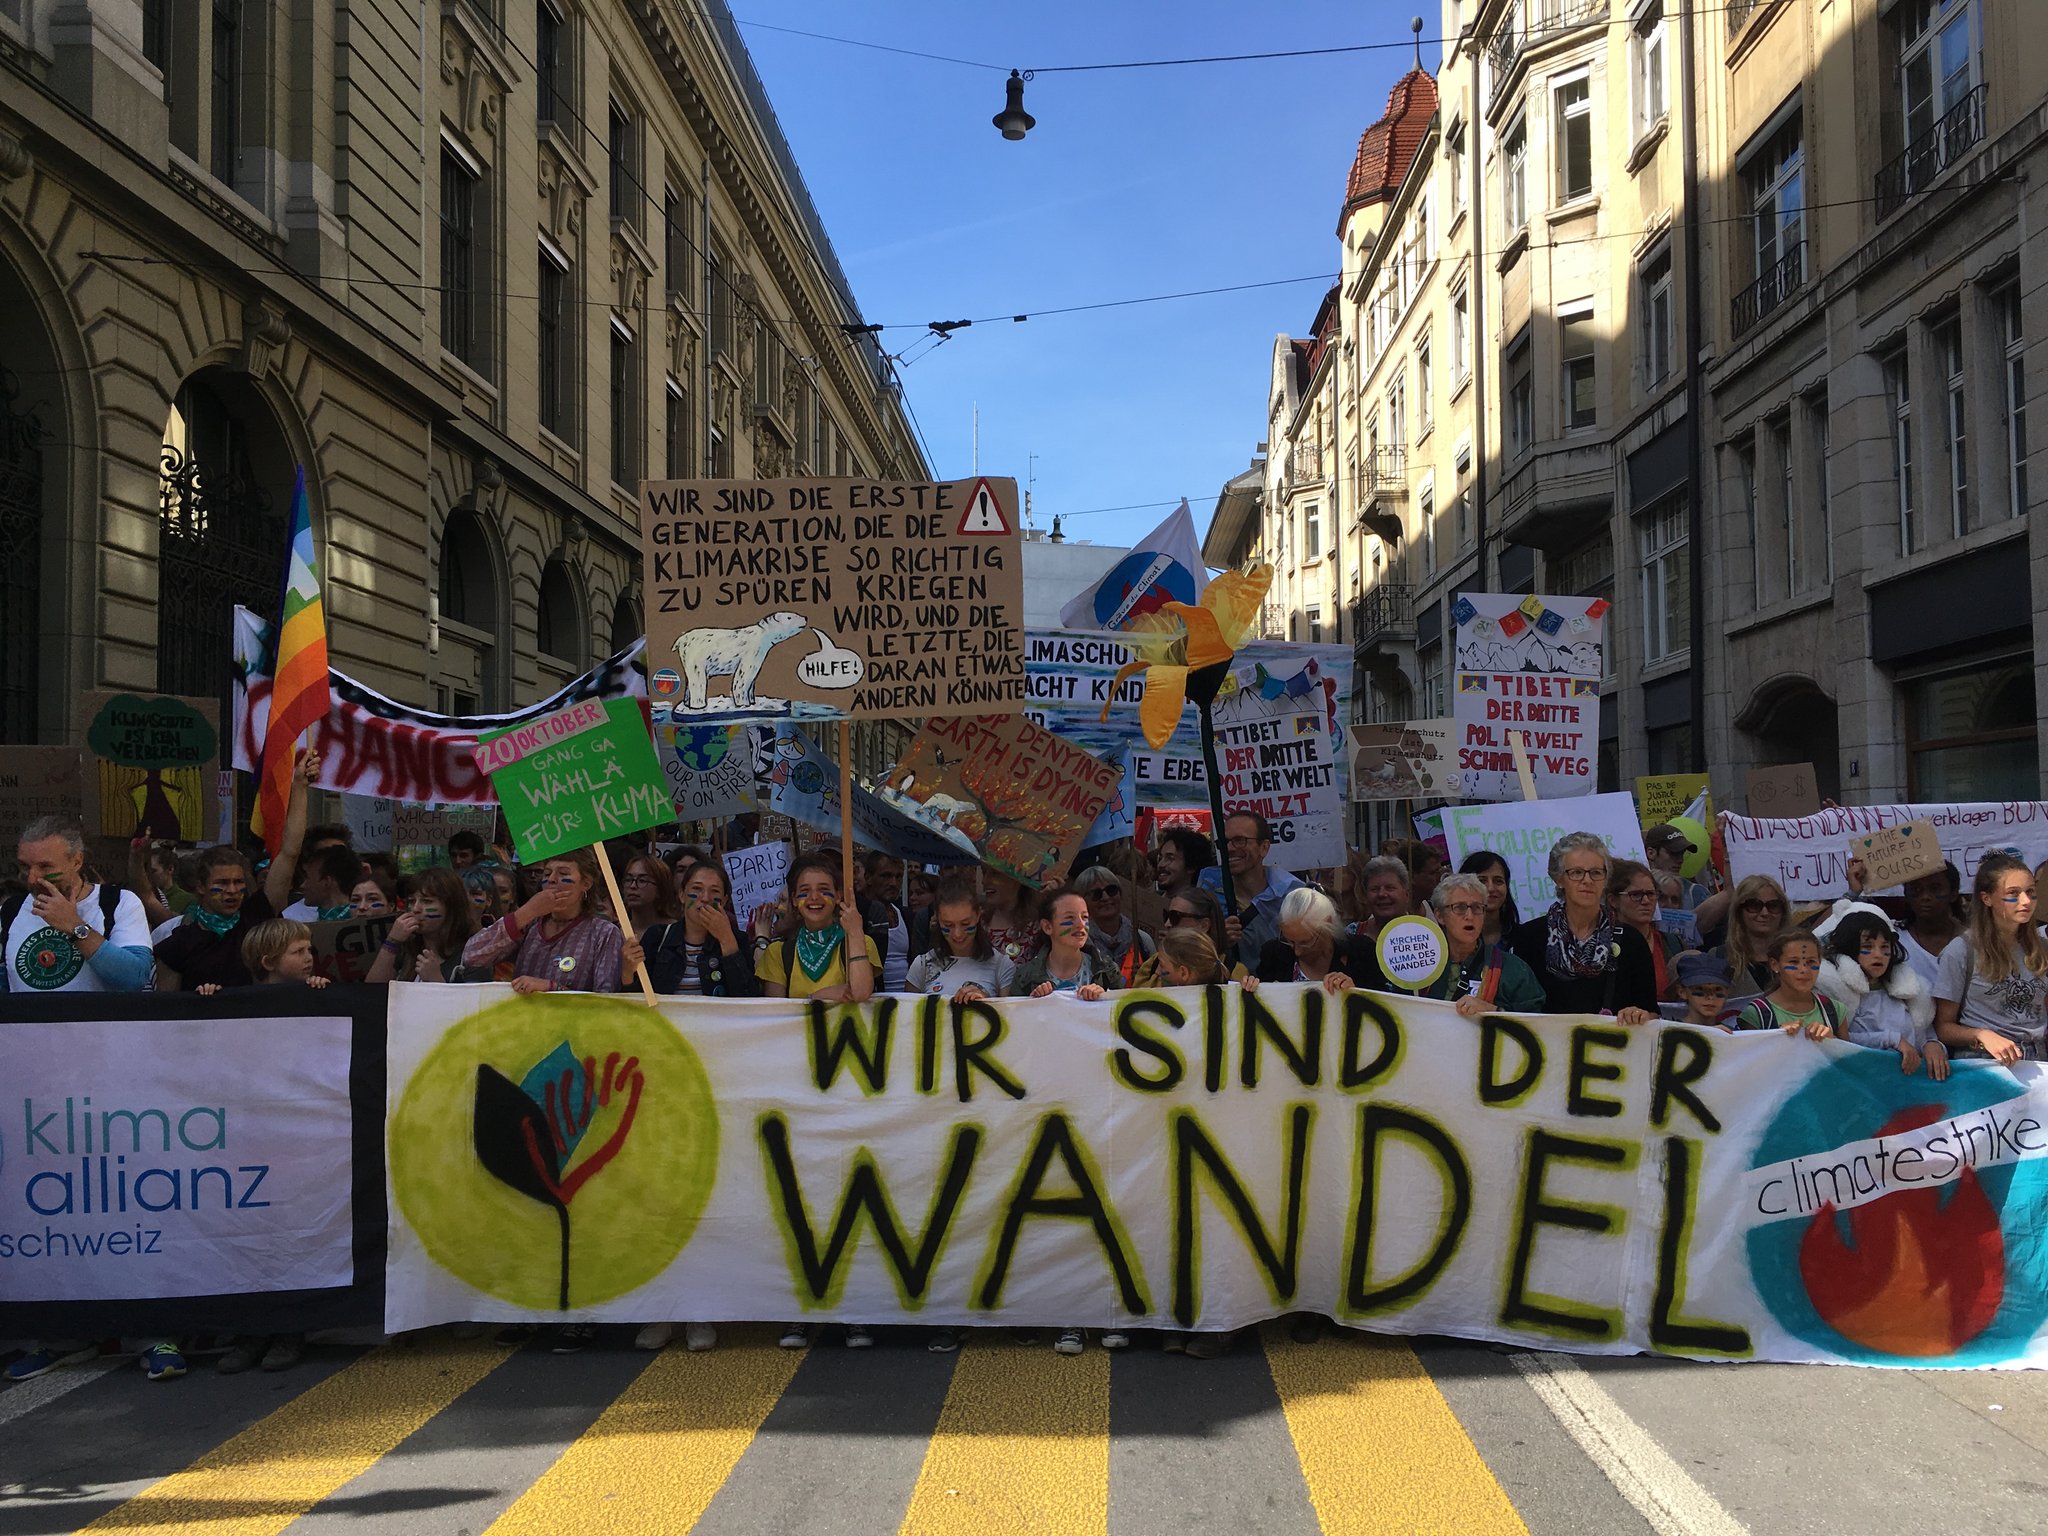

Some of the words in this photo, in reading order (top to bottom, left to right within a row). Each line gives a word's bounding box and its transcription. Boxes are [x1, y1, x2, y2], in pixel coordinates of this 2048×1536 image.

[648, 488, 703, 515] WIR
[713, 488, 774, 513] SIND
[789, 487, 832, 510] DIE
[850, 485, 953, 510] ERSTE
[652, 515, 846, 545] GENERATION,
[854, 514, 894, 540] DIE
[905, 514, 947, 540] DIE
[654, 546, 830, 582] KLIMAKRISE
[846, 545, 880, 572] SO
[892, 545, 1003, 574] RICHTIG
[1137, 565, 1161, 592] Climat
[657, 586, 701, 612] ZU
[715, 575, 831, 605] SPÜREN
[857, 574, 986, 602] KRIEGEN
[833, 604, 909, 633] WIRD,
[916, 604, 959, 627] UND
[969, 605, 1009, 628] DIE
[867, 629, 977, 657] LETZTE,
[984, 629, 1019, 652] DIE
[805, 660, 859, 677] HILFE!
[868, 657, 946, 683] DARAN
[955, 654, 1024, 677] ETWAS
[851, 683, 936, 711] ÄNDERN
[947, 678, 1025, 705] KÖNNTE
[1091, 679, 1147, 702] KIND
[1493, 674, 1571, 698] TIBET
[1487, 698, 1524, 721] DER
[1527, 702, 1580, 723] DRITTE
[125, 728, 145, 744] IST
[476, 737, 515, 774] 20
[517, 703, 601, 750] OKTOBER
[1226, 719, 1281, 745] TIBET
[1382, 725, 1446, 738] Artenschutz
[1466, 723, 1498, 747] POL
[1503, 728, 1532, 748] DR
[1534, 731, 1583, 751] WELT
[109, 741, 200, 760] VERBRECHEN
[532, 745, 584, 771] GANG
[591, 737, 616, 753] GA
[1016, 723, 1115, 790] DENYING
[1225, 747, 1257, 772] DER
[1259, 738, 1318, 768] DRITTE
[1381, 748, 1444, 761] Klimaschutz
[1458, 748, 1539, 774] SCHMILT
[1543, 754, 1589, 776] WEG
[666, 760, 693, 787] OUR
[699, 753, 743, 788] HOUSE
[927, 716, 1009, 766] EARTH
[1009, 752, 1036, 779] IS
[1032, 765, 1104, 821] DYING
[1251, 769, 1282, 794] DER
[1283, 763, 1334, 789] WELT
[671, 786, 688, 803] IS
[693, 791, 714, 807] ON
[717, 771, 751, 800] FIRE
[1648, 790, 1675, 800] JUSTICE
[393, 811, 442, 826] WHICH
[446, 812, 492, 826] GREEN
[592, 783, 673, 832] KLIMA
[763, 815, 786, 827] THE
[1646, 806, 1668, 815] SANS
[397, 826, 419, 840] DO
[423, 826, 452, 840] YOU
[762, 825, 769, 834] IS
[1267, 820, 1296, 845] EG
[1875, 829, 1899, 846] THE
[728, 847, 787, 880] PARIS
[1866, 842, 1906, 865] FUTURE
[1911, 838, 1922, 849] IS
[1779, 860, 1801, 892] für
[1876, 854, 1924, 881] OURS
[17, 936, 38, 979] RUNNERS
[40, 929, 60, 939] FOR
[1393, 943, 1411, 953] FÜR
[1413, 942, 1429, 951] EIN
[1418, 949, 1436, 960] DES
[32, 965, 77, 987] SWITZERLAND
[1392, 958, 1436, 973] WANDELS
[806, 996, 1026, 1102] WIR
[1108, 984, 1404, 1095] SIND
[1479, 1014, 1722, 1134] DER
[24, 1096, 226, 1155] klima
[1757, 1109, 2048, 1215] climatestrike
[25, 1155, 271, 1216] allianz
[0, 1223, 162, 1258] schweiz
[758, 1102, 1753, 1357] WANDEL
